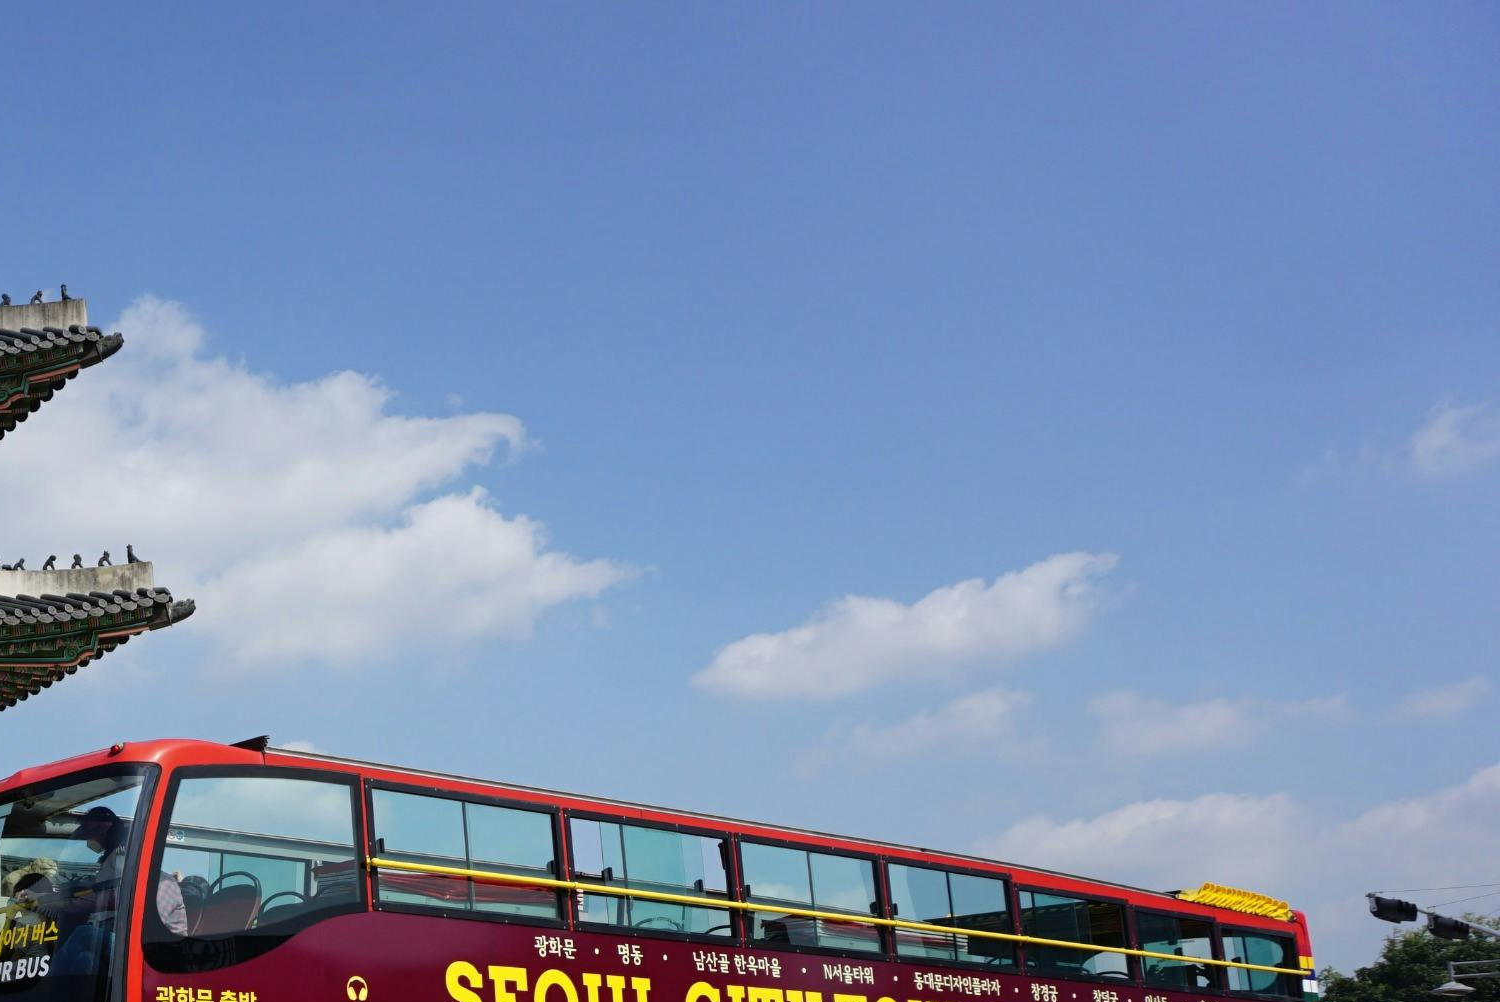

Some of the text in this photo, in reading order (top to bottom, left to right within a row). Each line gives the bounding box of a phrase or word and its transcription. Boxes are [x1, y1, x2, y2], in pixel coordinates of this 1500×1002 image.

[31, 920, 59, 945] 버스
[15, 954, 51, 980] BUS
[534, 935, 577, 960] 광화문
[617, 943, 644, 966] 명동
[692, 950, 731, 974] 남산골
[733, 954, 782, 978] 한옥마을
[822, 963, 875, 985] N서울타워
[913, 971, 1001, 996] 동대문디자인플라자
[1031, 983, 1059, 1002] 창경궁
